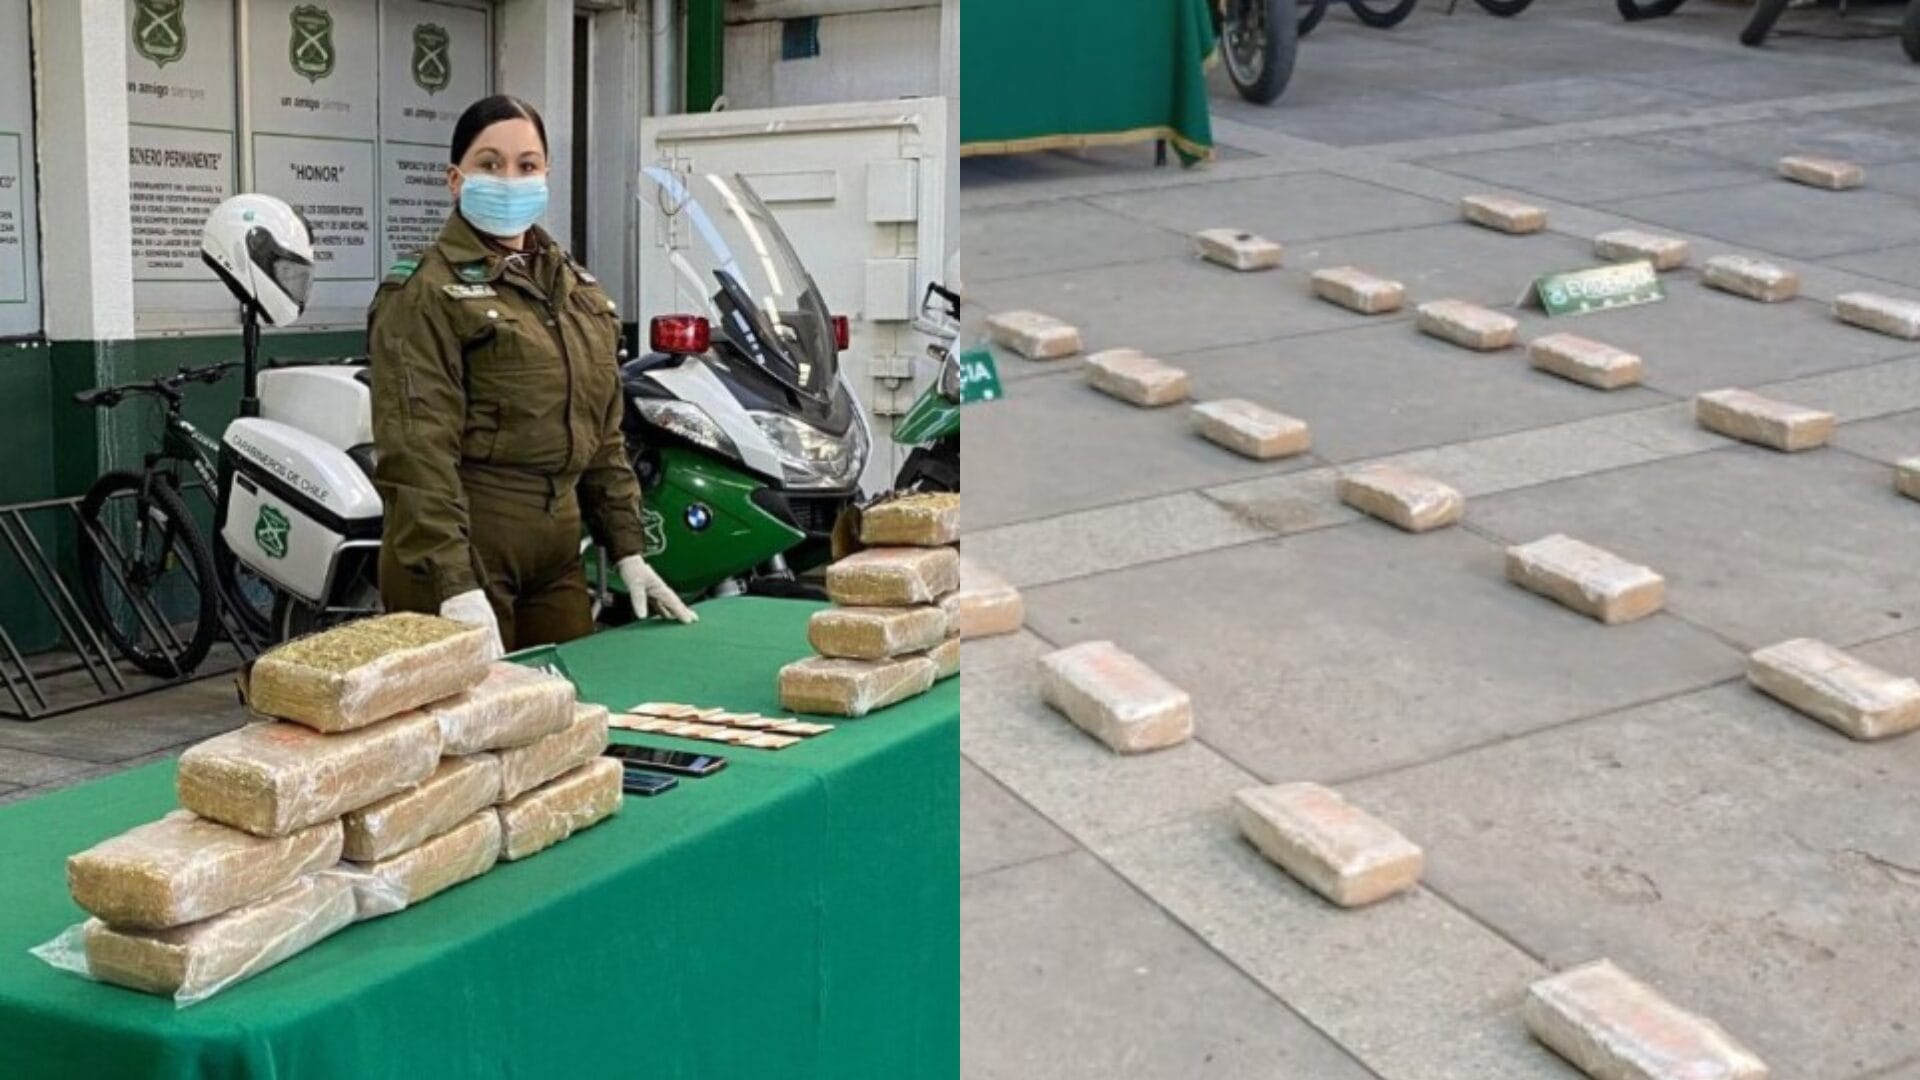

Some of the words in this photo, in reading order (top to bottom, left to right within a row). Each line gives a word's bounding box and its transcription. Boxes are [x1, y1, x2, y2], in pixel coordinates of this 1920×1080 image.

[139, 82, 168, 98] amigo
[281, 97, 292, 107] un
[294, 97, 320, 111] amigo
[290, 163, 345, 183] "HONOR"
[232, 434, 286, 476] CARABINEROS
[287, 470, 300, 486] DE
[301, 478, 329, 502] CHILE
